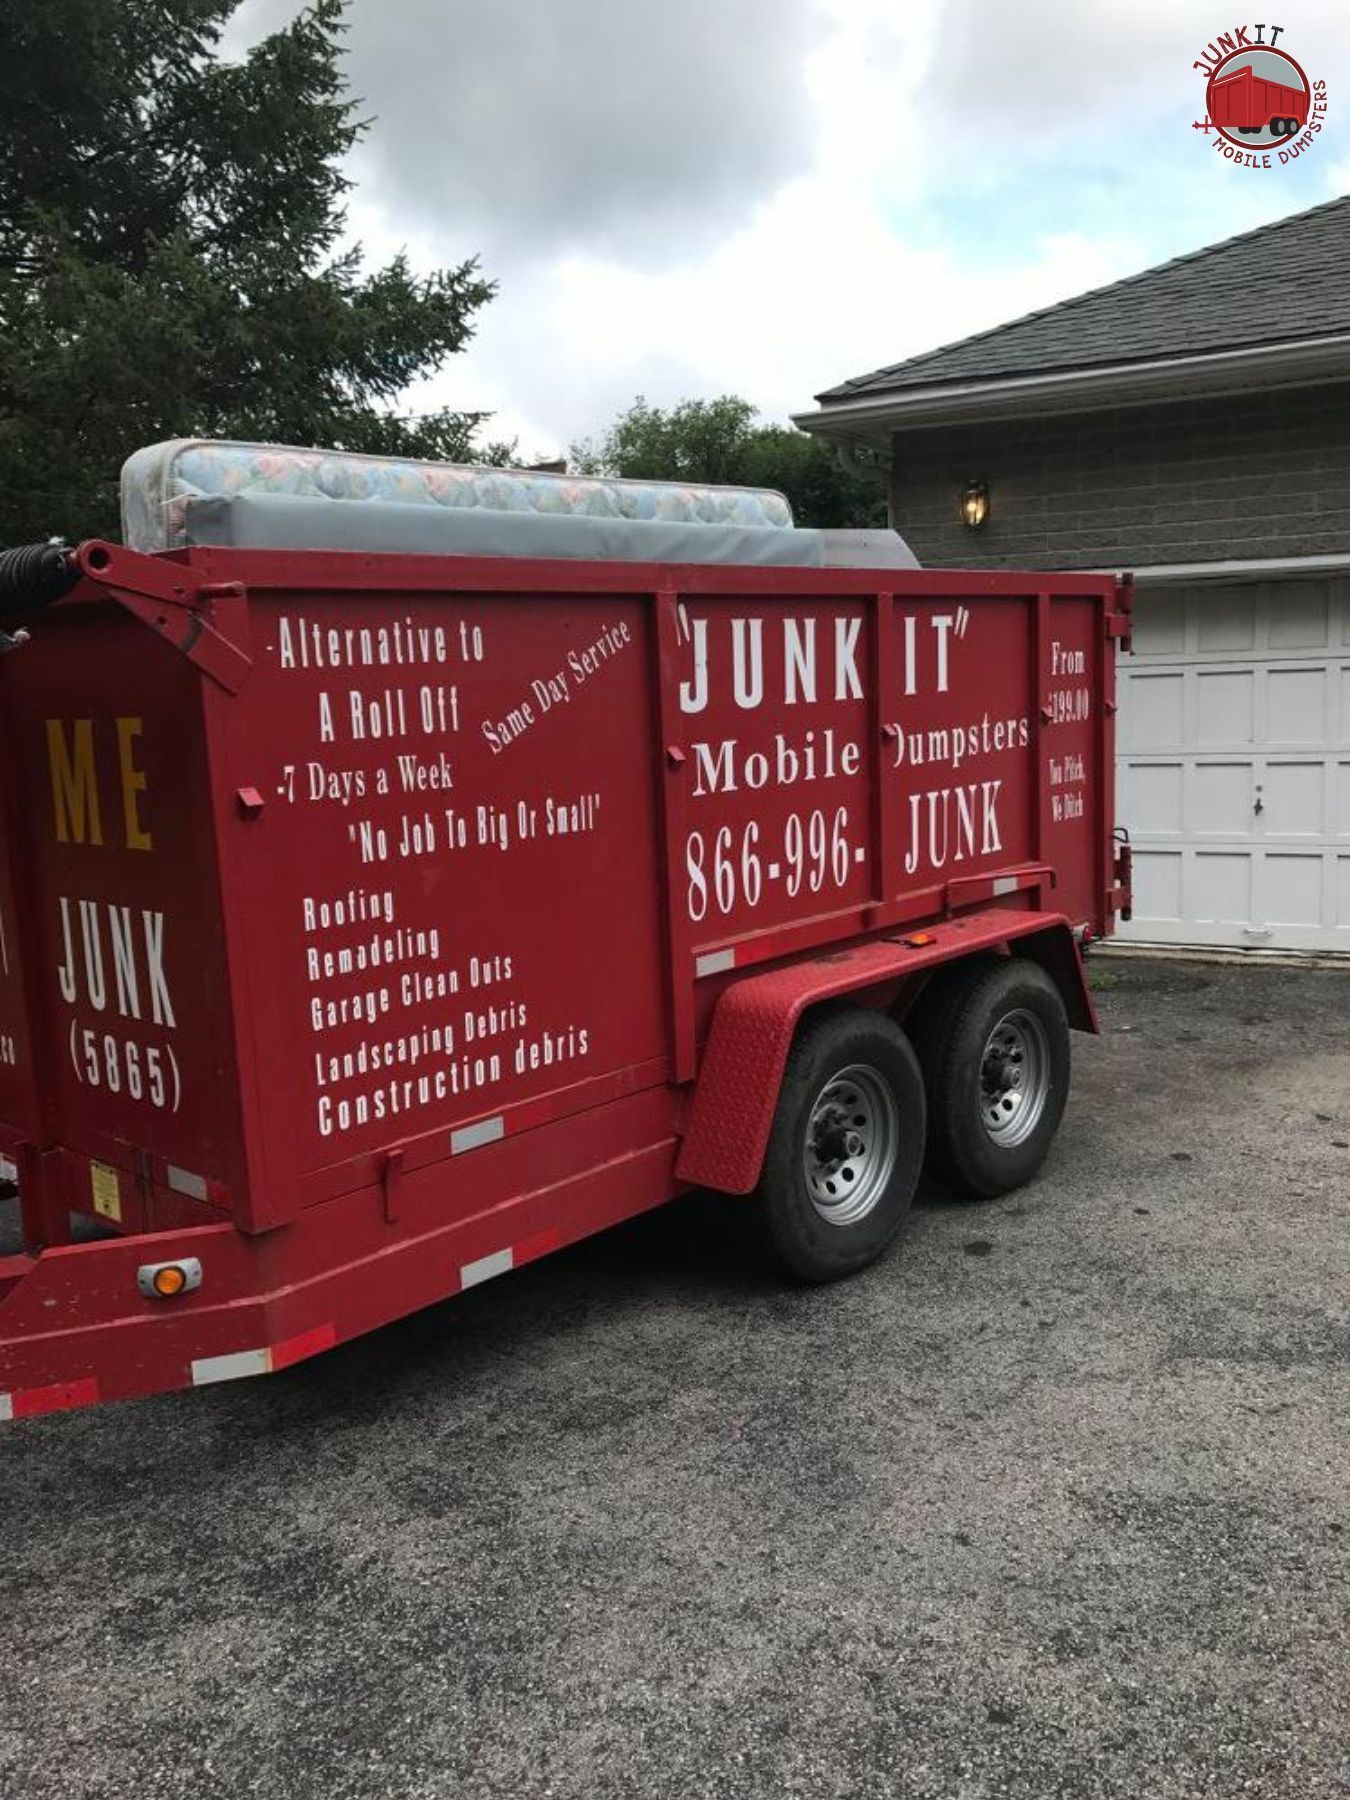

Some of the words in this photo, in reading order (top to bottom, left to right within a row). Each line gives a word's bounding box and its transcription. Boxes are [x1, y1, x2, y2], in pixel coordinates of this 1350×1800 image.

[267, 617, 446, 668] -Alternative
[460, 621, 483, 661] to
[1052, 642, 1084, 675] From
[320, 693, 334, 742] A
[350, 689, 405, 739] Roll
[421, 686, 458, 733] Off
[481, 699, 535, 755] Same
[531, 671, 571, 713] Day
[567, 621, 631, 684] Service
[44, 716, 153, 853] ME
[278, 766, 294, 803] -7
[308, 763, 365, 806] Days
[377, 769, 388, 794] a
[398, 753, 453, 791] Week
[692, 730, 859, 796] Mobile
[400, 813, 435, 856] Job
[446, 810, 466, 848] To
[477, 806, 507, 850] Big
[518, 801, 536, 839] Or
[687, 807, 864, 921] 866-996-
[905, 780, 1003, 874] JUNK
[304, 890, 394, 931] Roofing
[58, 897, 176, 1028] JUNK
[311, 988, 389, 1032] Garage
[402, 971, 458, 1005] Clean
[471, 956, 511, 987] Outs
[70, 1018, 181, 1113] (5865)
[315, 1025, 454, 1086] Landscaping
[465, 1001, 527, 1042] Debris
[318, 1055, 501, 1136] Construction
[515, 1026, 589, 1074] debris
